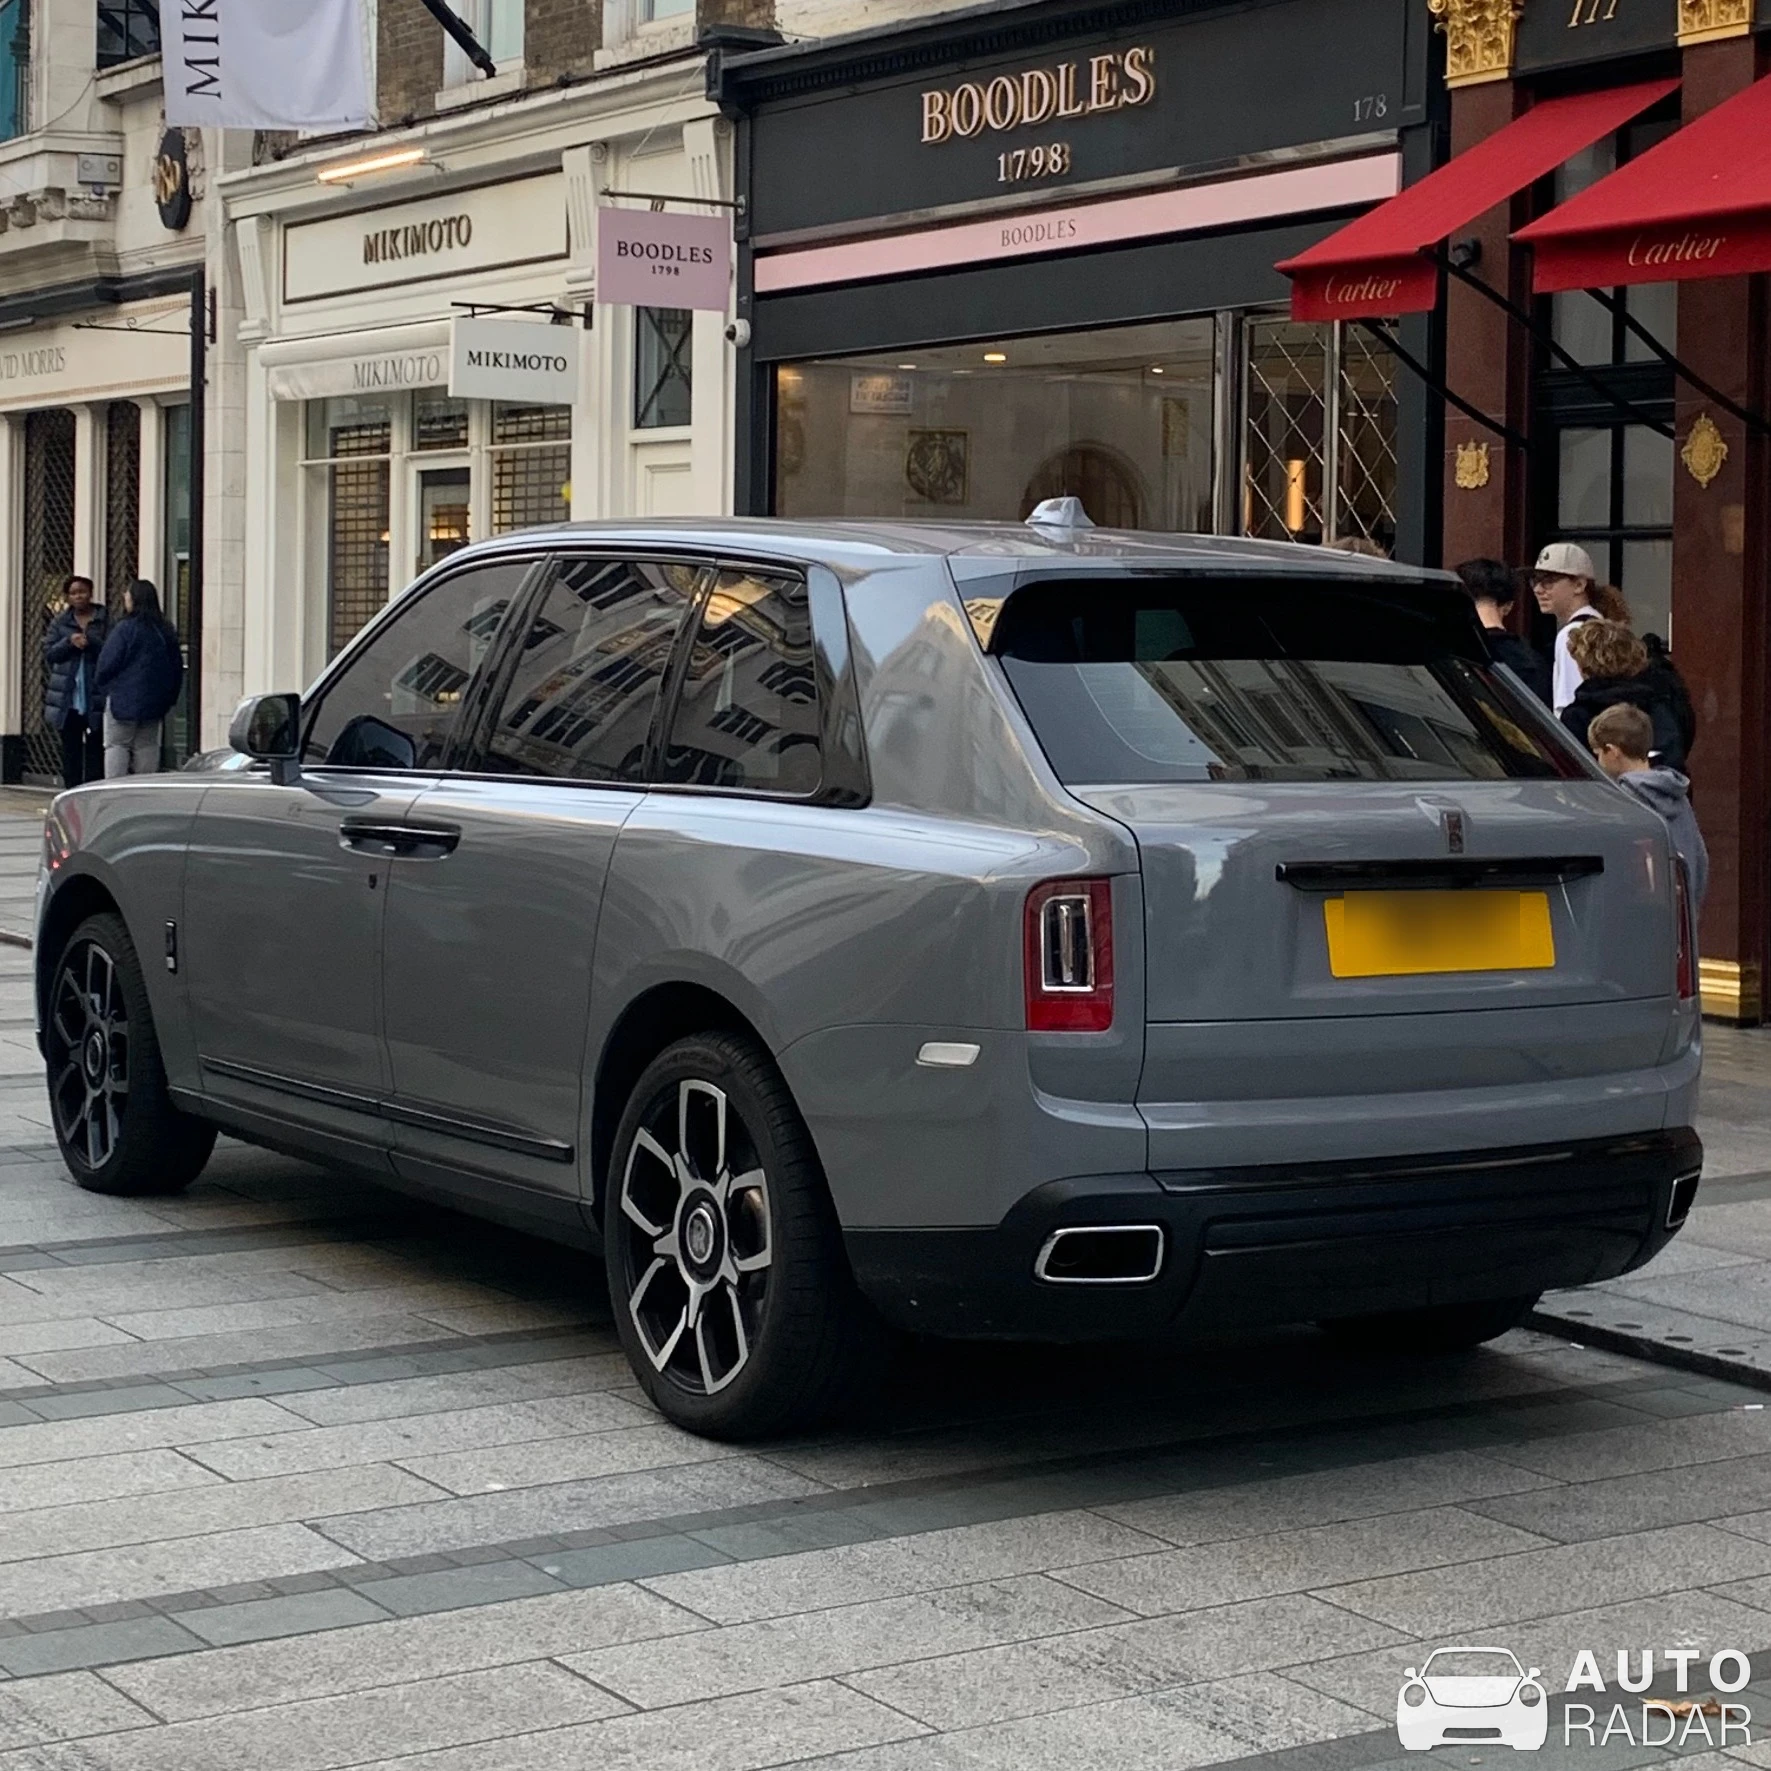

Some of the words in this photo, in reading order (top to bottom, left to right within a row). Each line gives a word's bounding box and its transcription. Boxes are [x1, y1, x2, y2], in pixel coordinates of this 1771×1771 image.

[181, 0, 221, 99] MIK
[921, 47, 1155, 144] BOODLES
[1353, 94, 1387, 121] 178
[997, 143, 1069, 182] 1798
[363, 213, 473, 265] MIKIMOTO
[1001, 219, 1077, 247] BOODLES
[616, 240, 714, 264] BOODLES
[1628, 233, 1727, 267] Cartier
[650, 265, 680, 276] 1798
[1324, 274, 1401, 304] Cartier
[21, 346, 65, 377] MORRIS
[352, 354, 440, 389] MIKIMOTO
[466, 349, 568, 372] MIKIMOTO
